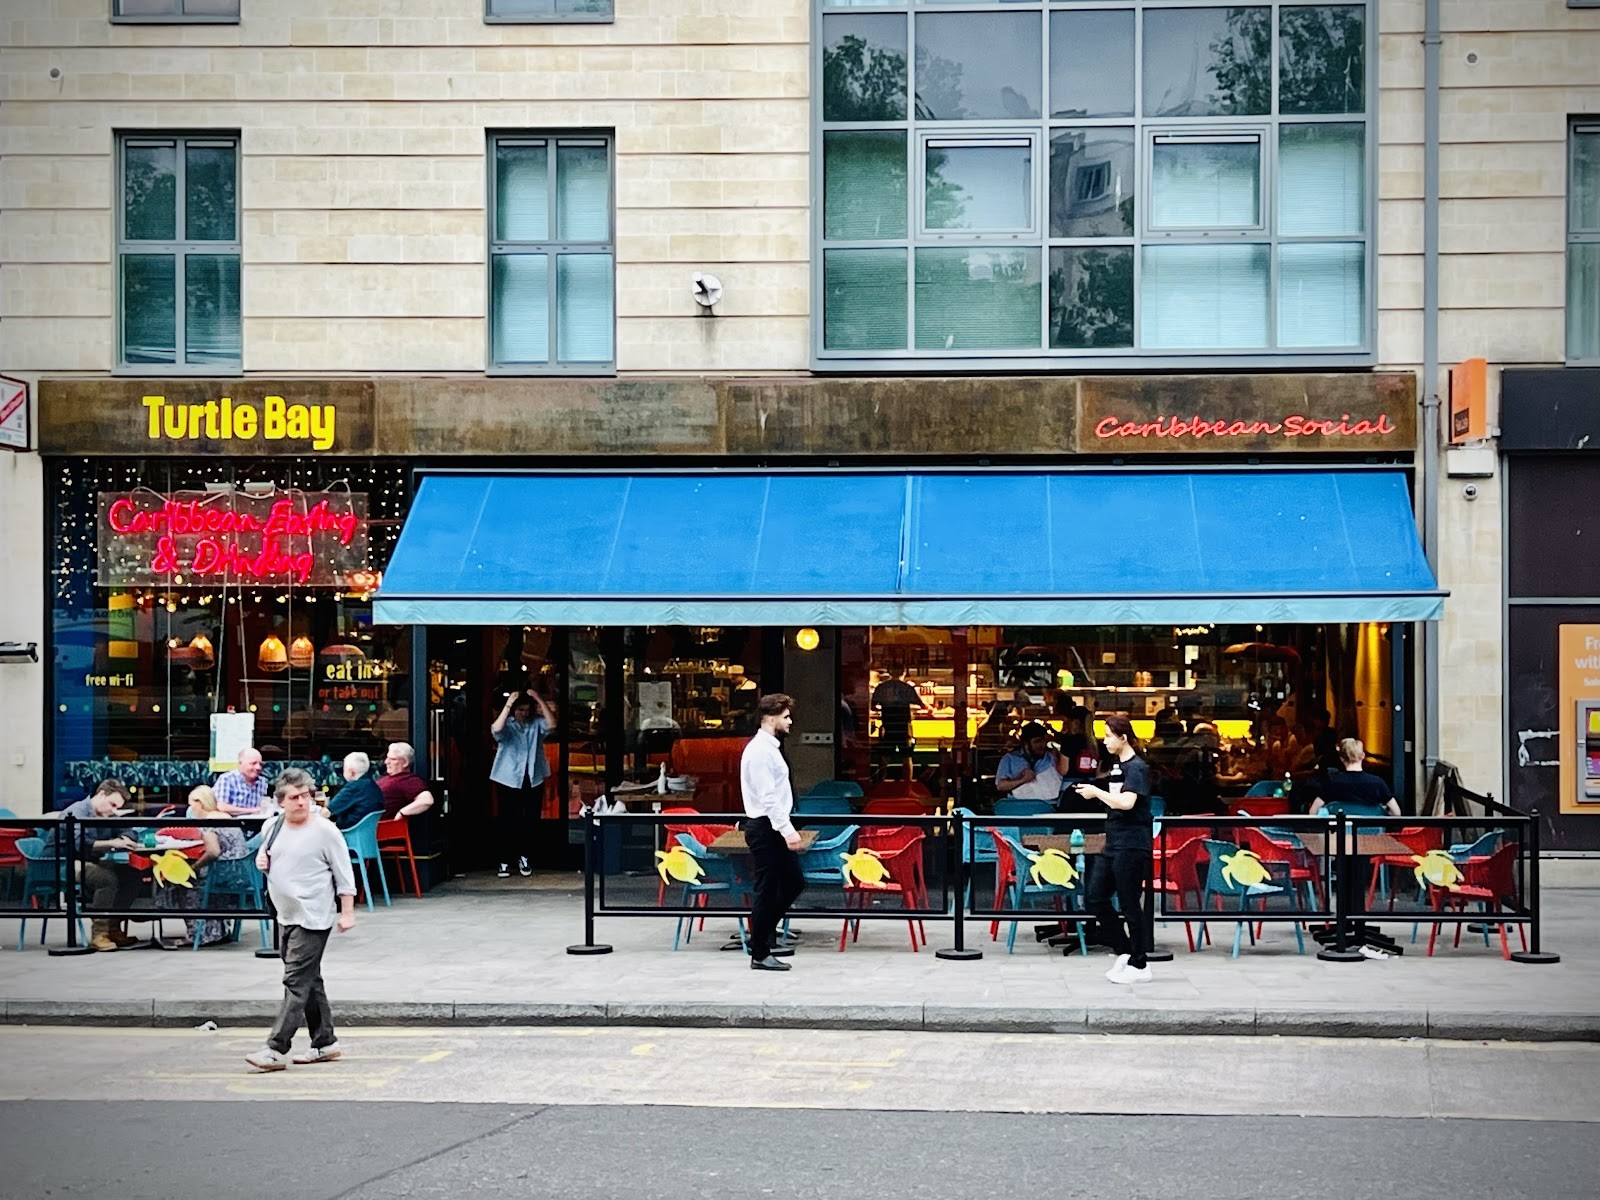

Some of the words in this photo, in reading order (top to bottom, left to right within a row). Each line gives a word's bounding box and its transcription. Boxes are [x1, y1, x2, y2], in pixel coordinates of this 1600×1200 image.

[143, 396, 257, 439] Turtle
[264, 396, 335, 450] Bay
[1095, 415, 1282, 438] Caribbean
[1283, 414, 1396, 437] Social
[109, 499, 261, 533] Caribbean
[151, 537, 180, 574] &
[192, 537, 313, 583] Drinking
[85, 674, 107, 687] free
[109, 673, 134, 687] wi-fi
[326, 660, 353, 681] eat
[358, 660, 372, 680] in
[318, 688, 329, 698] or
[333, 686, 358, 700] take
[361, 686, 379, 699] out
